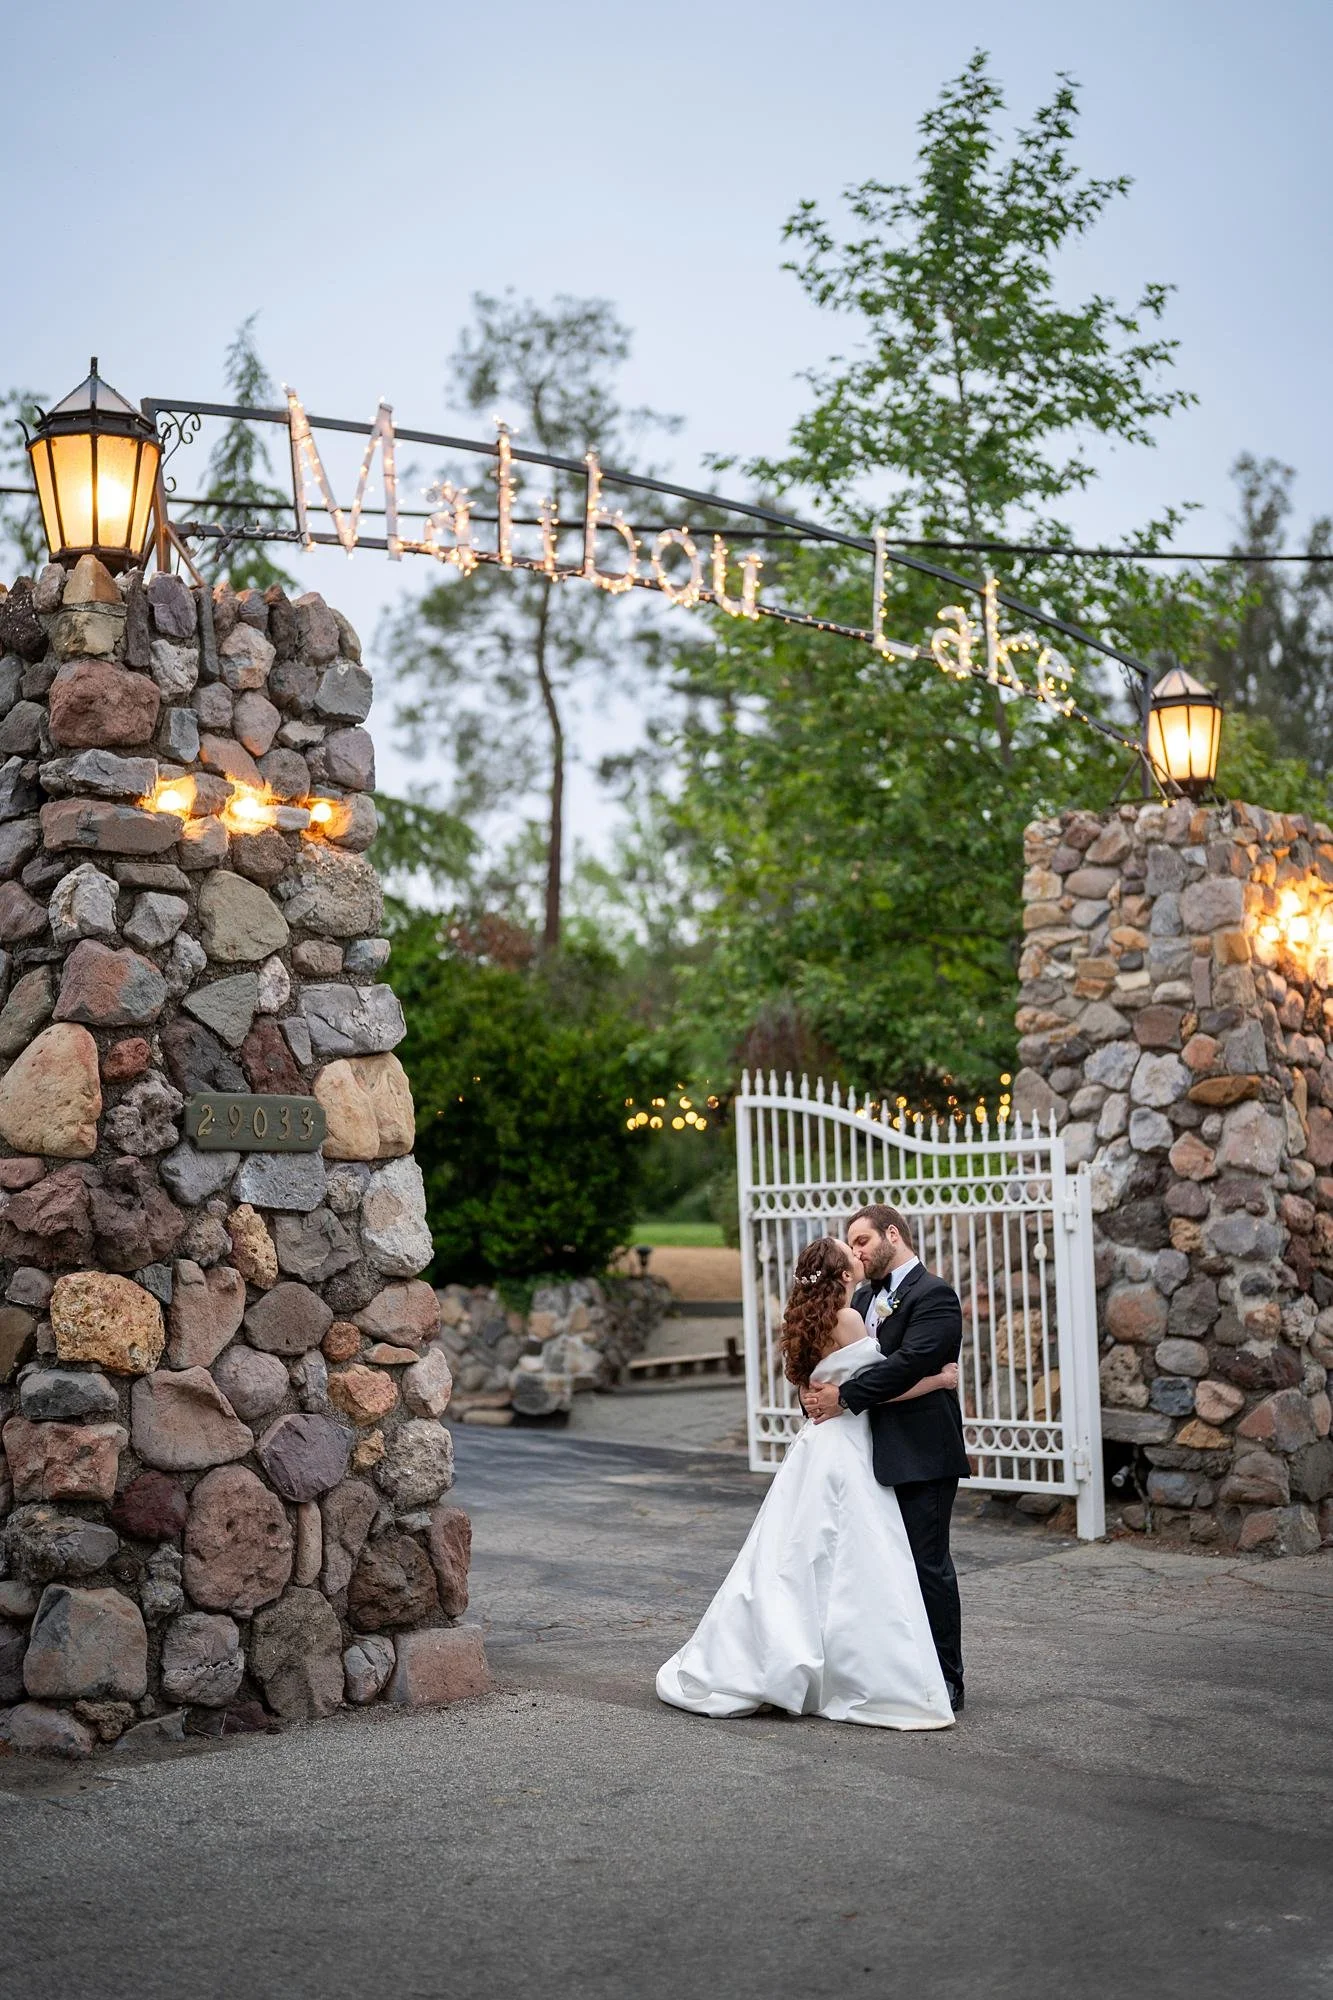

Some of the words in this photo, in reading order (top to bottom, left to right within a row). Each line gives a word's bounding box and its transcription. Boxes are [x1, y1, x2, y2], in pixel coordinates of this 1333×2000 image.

[285, 385, 764, 621] Malibou
[872, 528, 1075, 717] Lake
[197, 1103, 314, 1141] 29033
